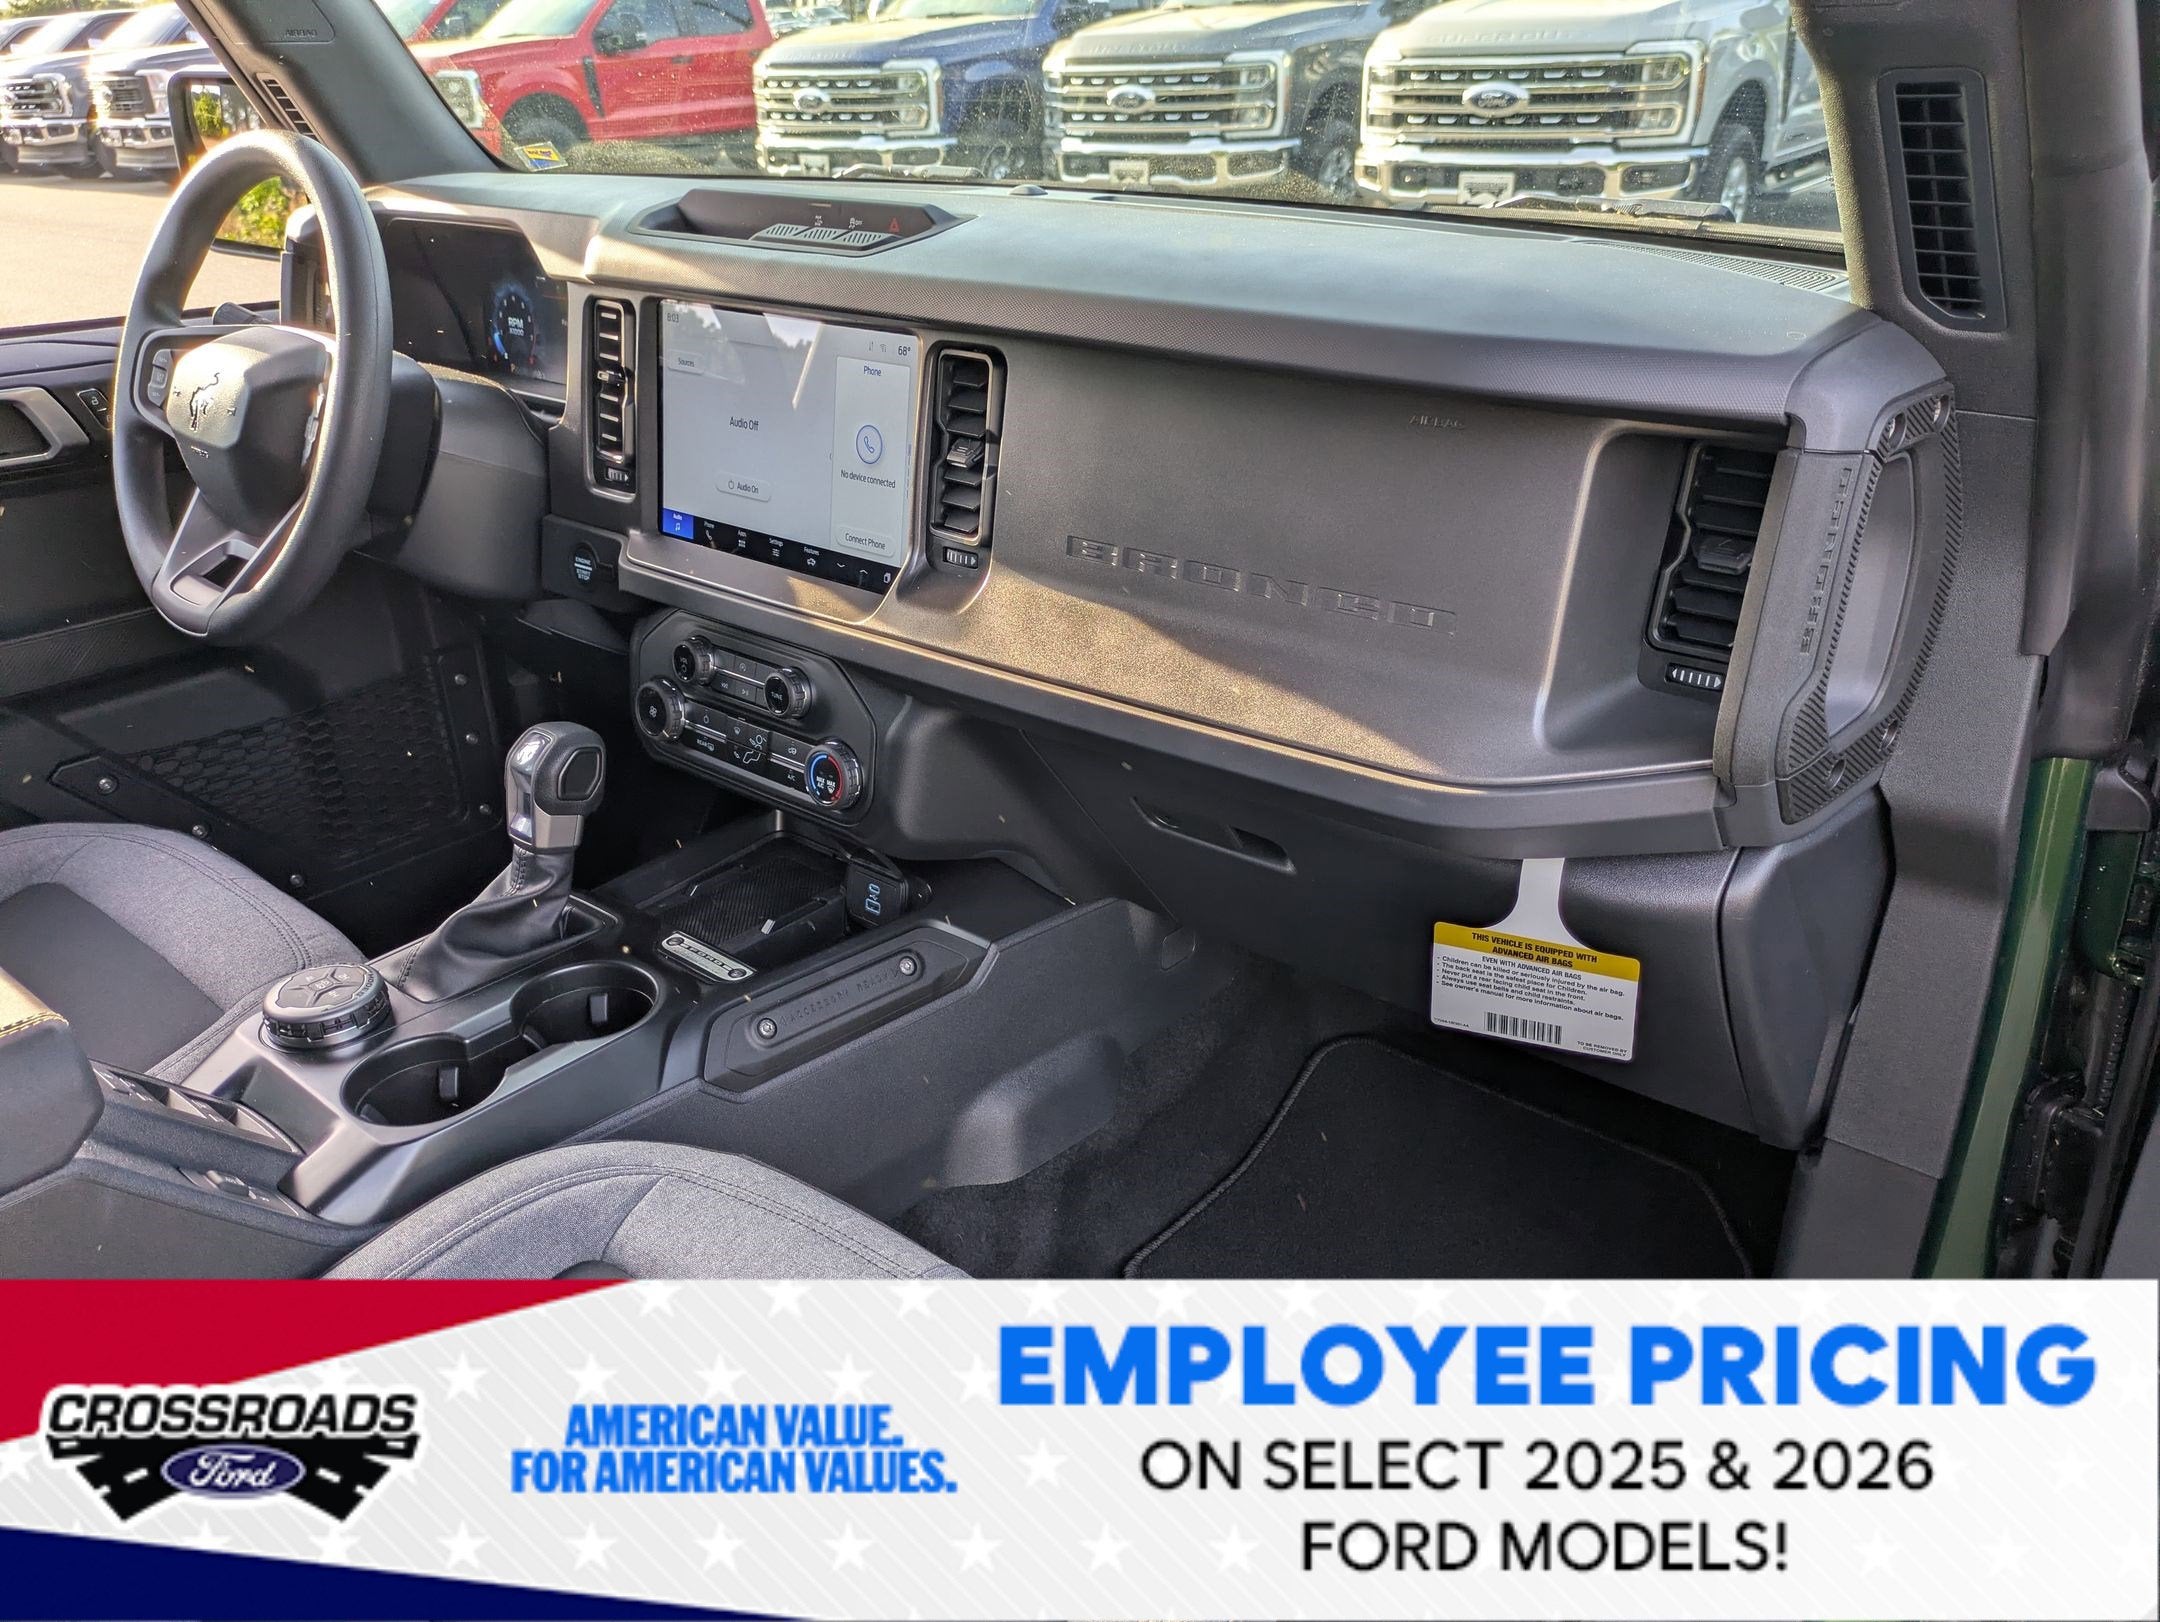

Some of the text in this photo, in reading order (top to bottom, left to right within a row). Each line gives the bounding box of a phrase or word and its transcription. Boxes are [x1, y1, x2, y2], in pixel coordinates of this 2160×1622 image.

[508, 317, 524, 329] RPM
[863, 365, 882, 377] Phone
[729, 416, 759, 431] Audio Off
[736, 481, 760, 495] Audio On
[840, 469, 896, 489] No device connected
[844, 532, 886, 550] Connect Phone
[1072, 534, 1459, 638] BRONCO
[1472, 932, 1597, 963] THIS VEHICLE IS EQUIPPED WITH
[1492, 946, 1573, 967] ADVANCED AIR BAGS
[1442, 956, 1469, 966] Children
[1493, 966, 1510, 974] killed
[1520, 972, 1550, 982] seriously
[1552, 977, 1575, 987] injured
[1577, 982, 1585, 990] by
[1482, 956, 1582, 980] EVEN WITH ADVANCED AIR BAGS
[1442, 968, 1460, 976] Never
[1493, 979, 1513, 988] facing
[1568, 993, 1586, 1001] front.
[1442, 975, 1464, 984] Always
[1542, 995, 1575, 1005] restraints.
[1506, 975, 1526, 983] safest
[1527, 978, 1544, 987] place
[1557, 985, 1588, 996] Children.
[1481, 989, 1504, 998] manual
[1535, 999, 1572, 1011] information
[1574, 1007, 1593, 1015] about
[1604, 1012, 1624, 1021] bags.
